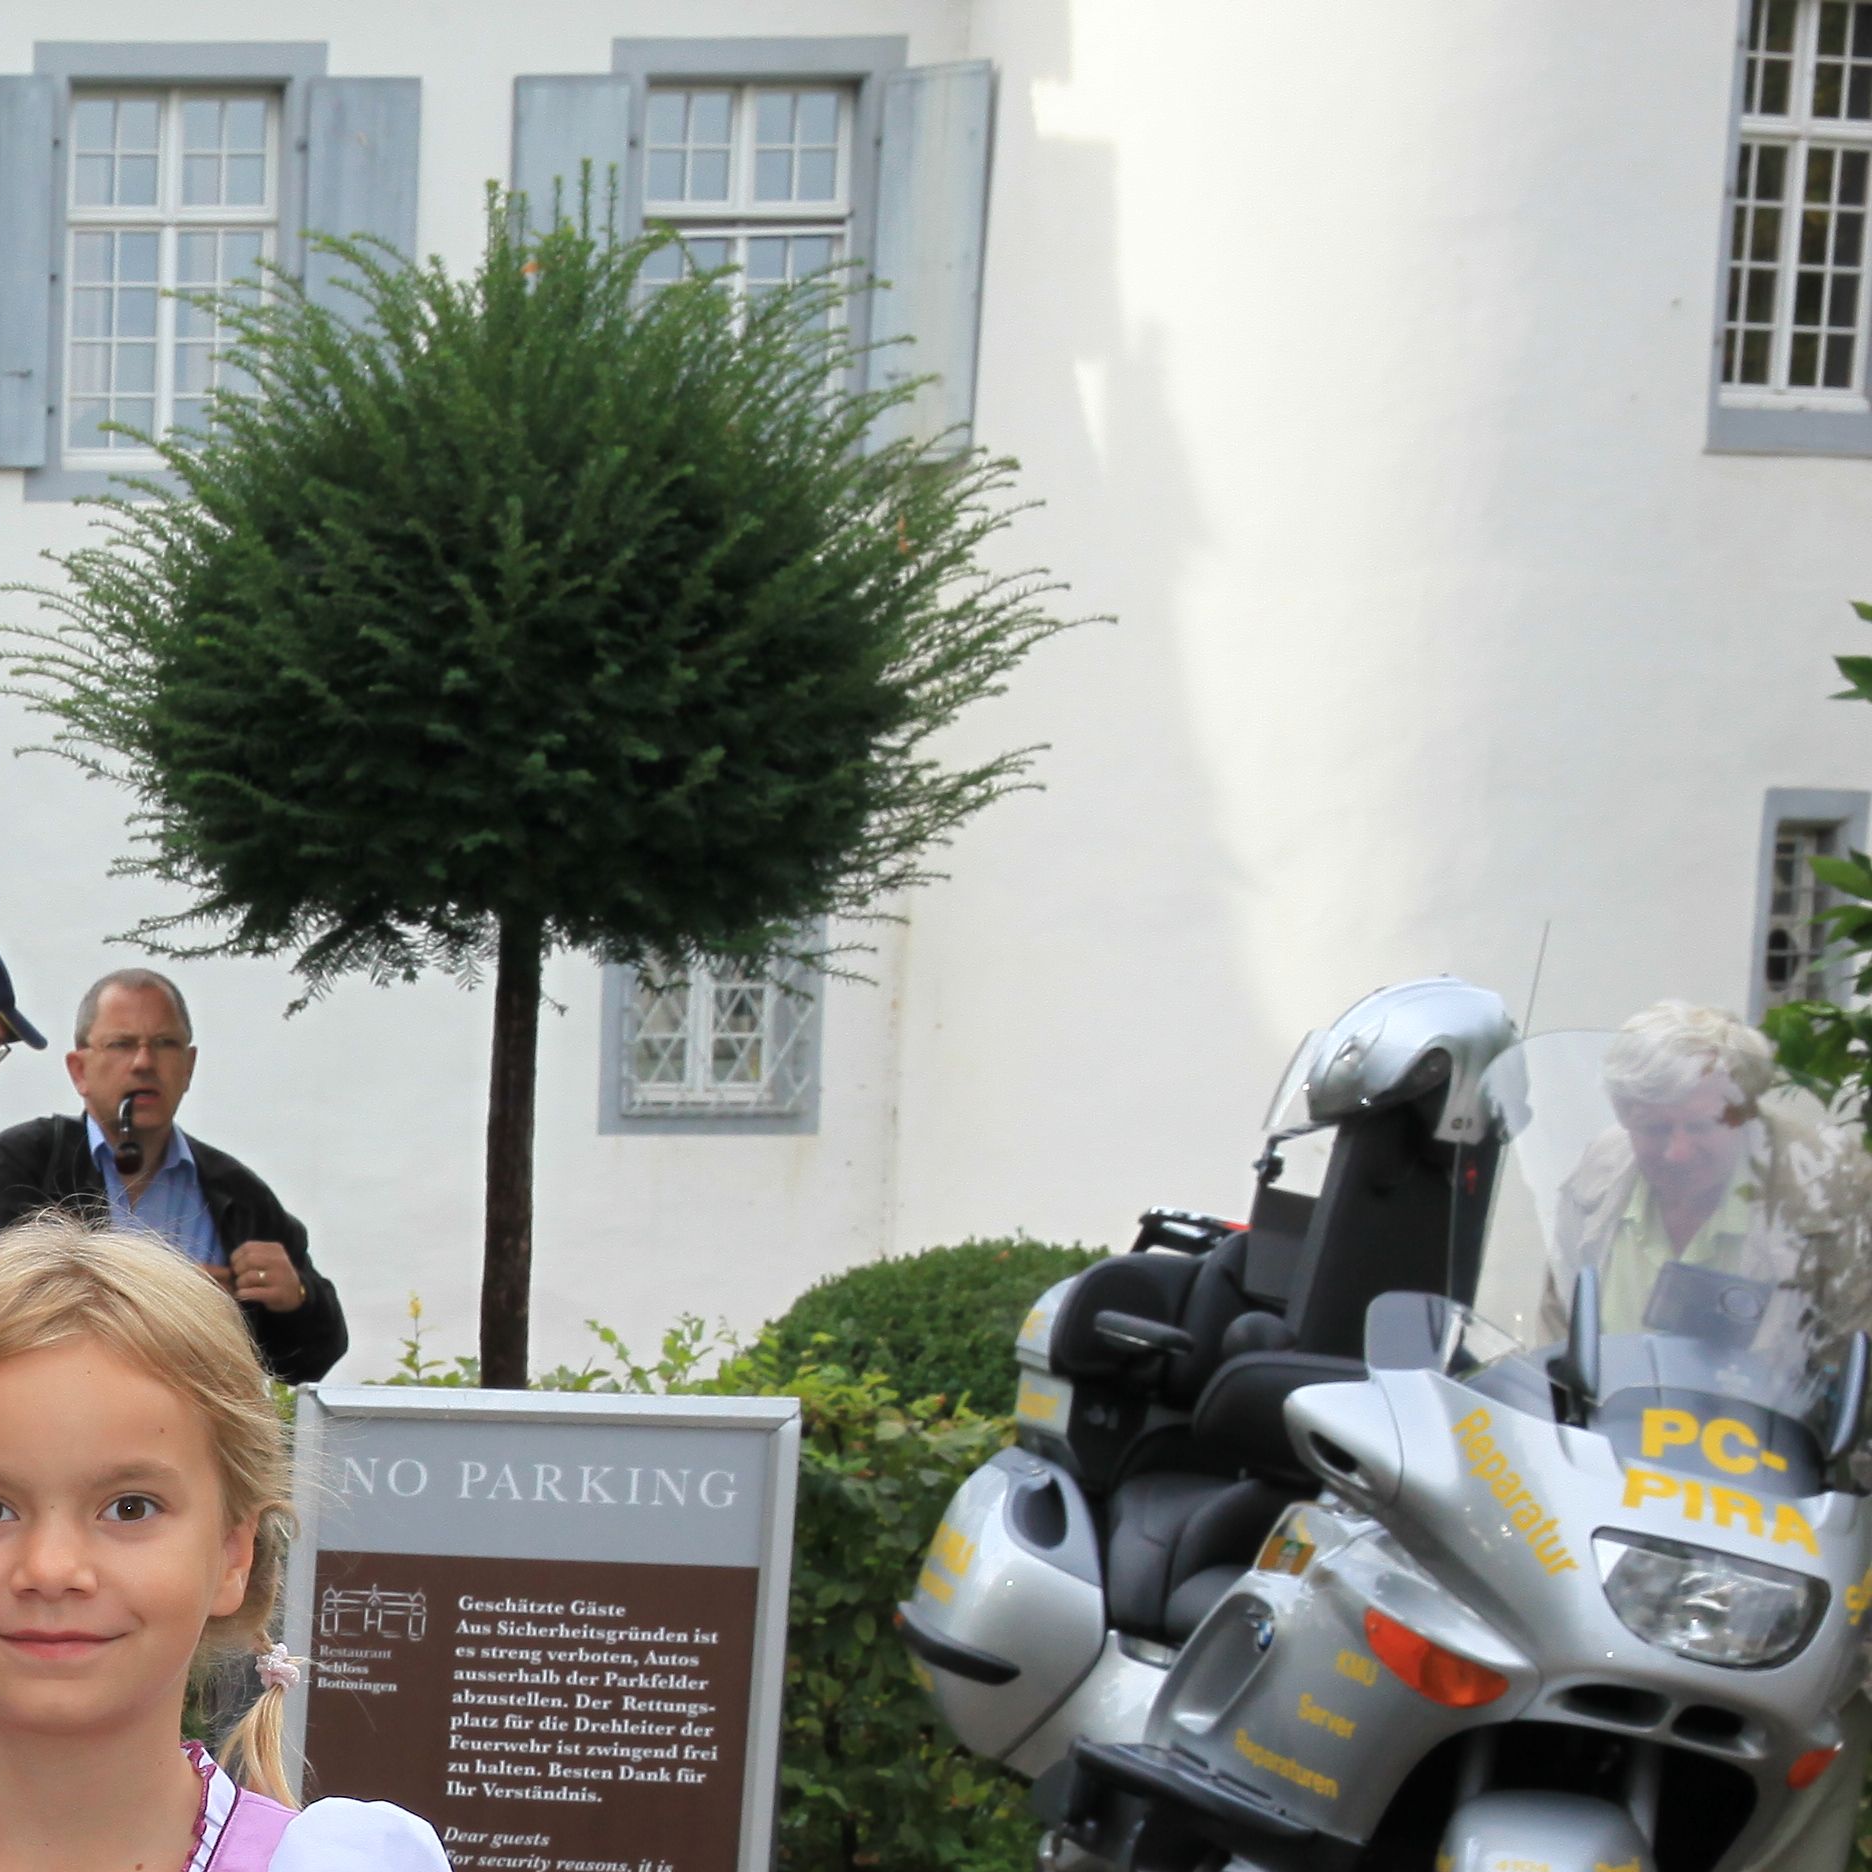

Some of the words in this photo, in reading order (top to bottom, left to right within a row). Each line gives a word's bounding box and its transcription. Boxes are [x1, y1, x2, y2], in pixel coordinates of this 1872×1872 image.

[1640, 1408, 1788, 1475] PC-
[341, 1457, 428, 1498] NO
[459, 1458, 740, 1508] PARKING
[1450, 1407, 1582, 1577] Reparatur
[1621, 1467, 1822, 1558] PIRA
[458, 1595, 564, 1615] Geschätzte
[570, 1599, 626, 1618] Gäste
[456, 1618, 491, 1635] Aus
[497, 1620, 689, 1645] Sicherheitsgründen
[693, 1628, 719, 1644] ist
[320, 1645, 392, 1659] Restaurant
[454, 1646, 475, 1658] es
[480, 1646, 542, 1664] streng
[547, 1647, 639, 1667] verboten,
[644, 1650, 700, 1667] Autos
[317, 1662, 369, 1675] Schloss
[453, 1667, 561, 1685] ausserhalb
[566, 1670, 599, 1687] der
[604, 1672, 709, 1691] Parkfelder
[317, 1677, 398, 1694] Bottmingen
[452, 1689, 569, 1708] abzustellen.
[575, 1693, 613, 1710] Der
[622, 1695, 716, 1718] Rettungs-
[450, 1712, 499, 1731] platz
[504, 1714, 534, 1730] für
[538, 1715, 569, 1731] die
[574, 1717, 676, 1737] Drehleiter
[680, 1722, 715, 1737] der
[449, 1734, 551, 1754] Feuerwehr
[556, 1739, 581, 1755] ist
[585, 1741, 678, 1762] zwingend
[682, 1745, 718, 1761] frei
[447, 1760, 470, 1773] zu
[474, 1759, 542, 1777] halten.
[548, 1762, 613, 1780] Besten
[618, 1765, 671, 1783] Dank
[676, 1767, 707, 1784] für
[445, 1780, 477, 1796] Ihr
[481, 1781, 603, 1802] Verständnis.
[444, 1826, 488, 1843] Dear
[489, 1832, 551, 1848] guests
[477, 1853, 551, 1872] security
